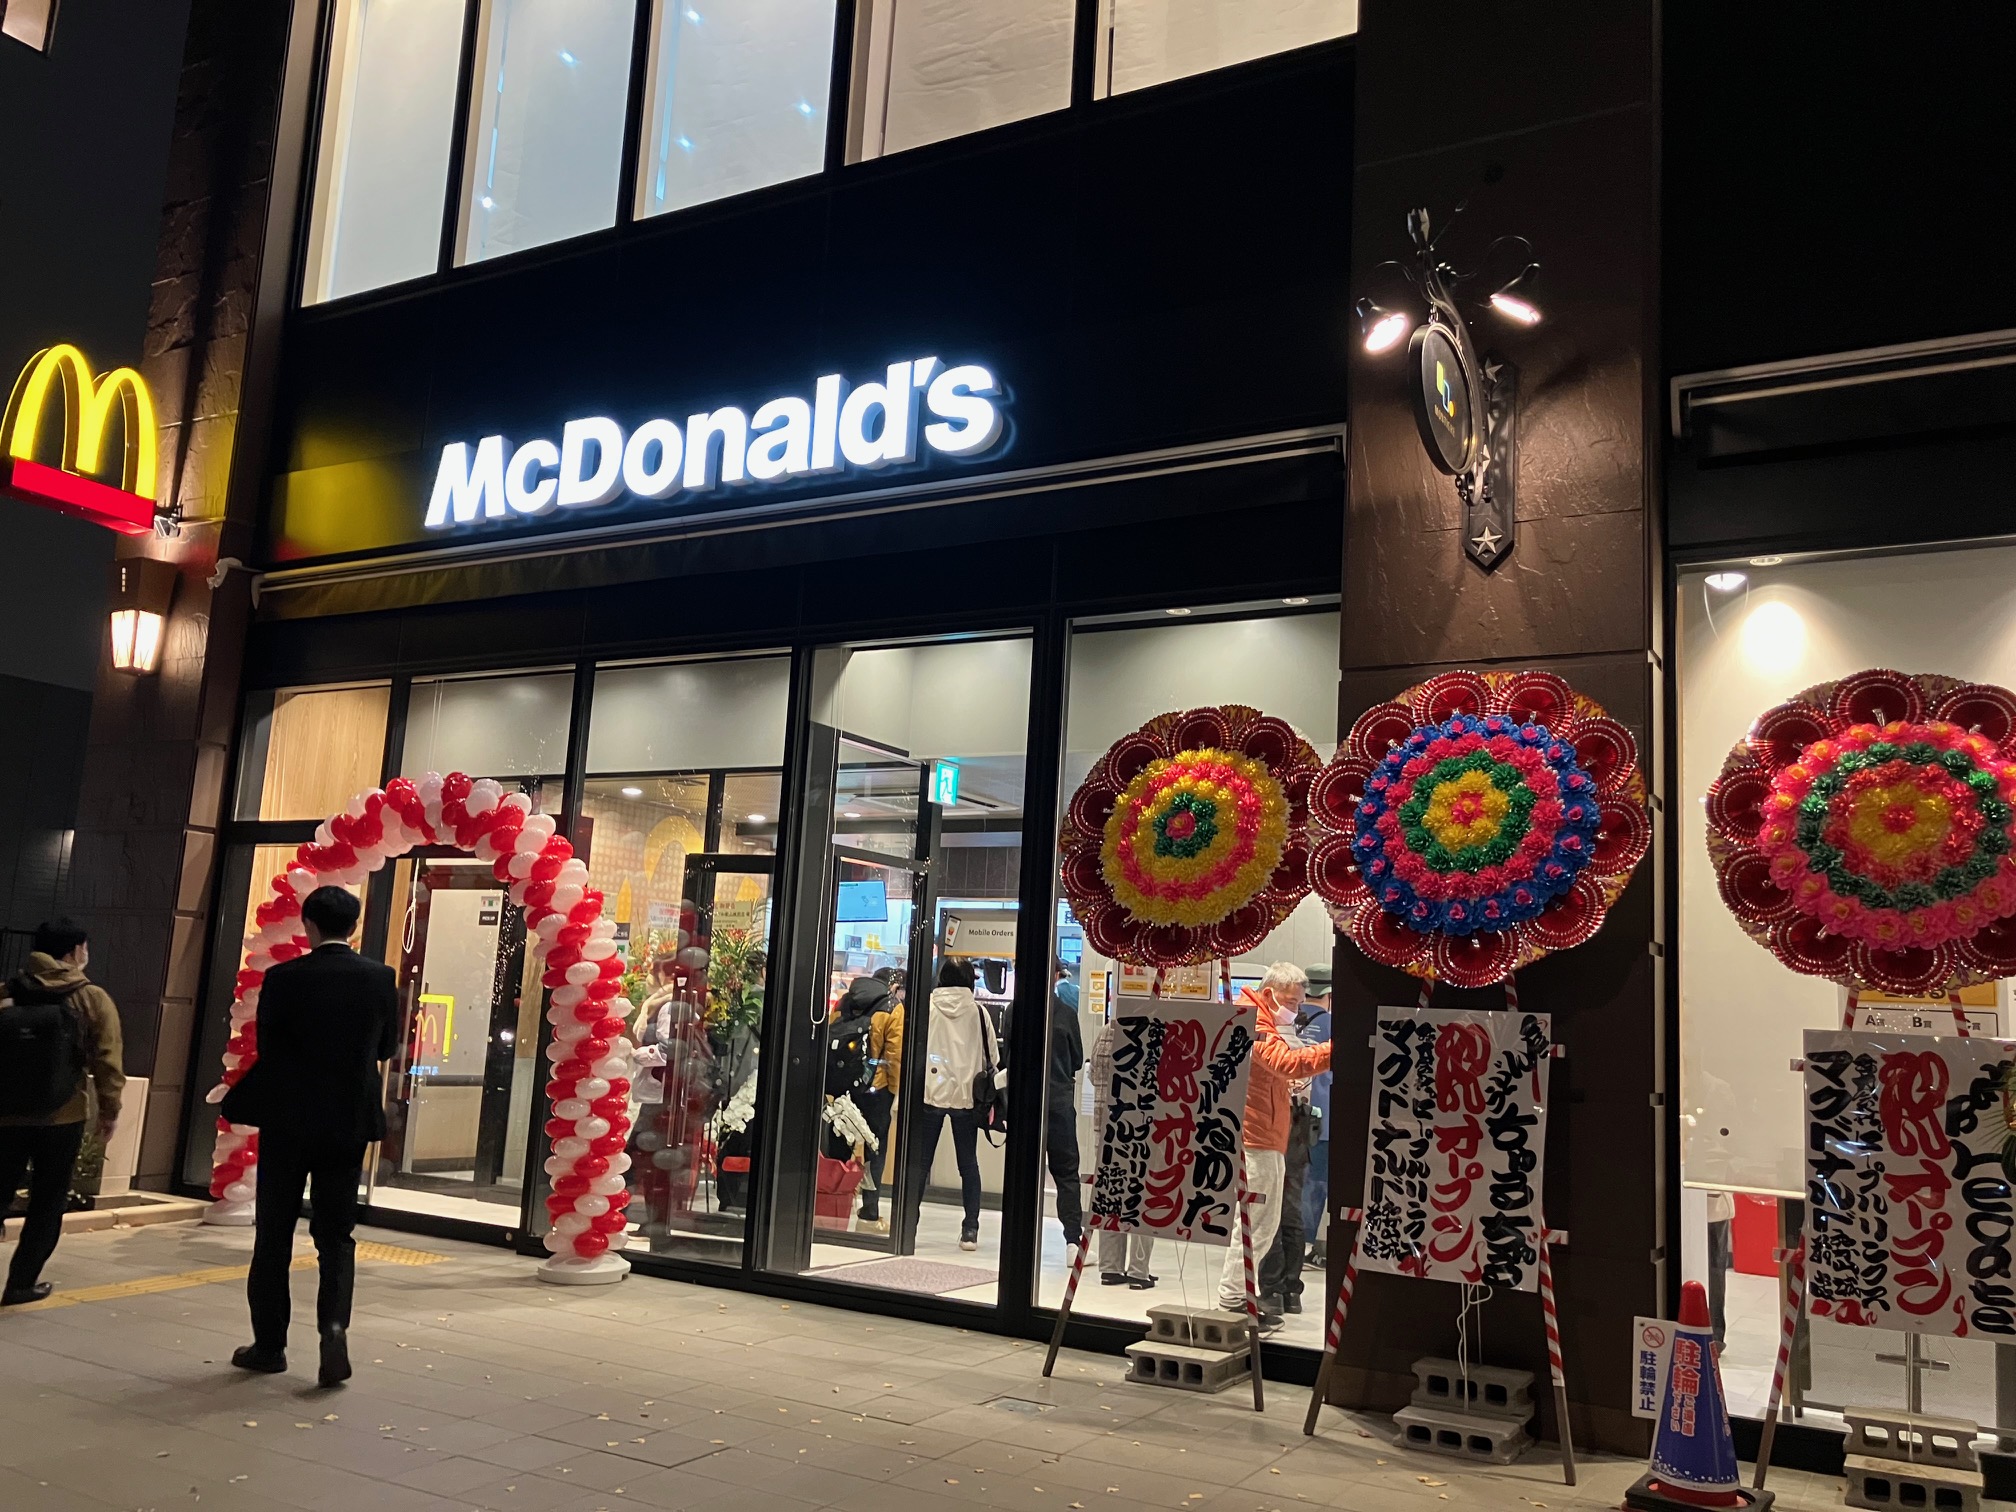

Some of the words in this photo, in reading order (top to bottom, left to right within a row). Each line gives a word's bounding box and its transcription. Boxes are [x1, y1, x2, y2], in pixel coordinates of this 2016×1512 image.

[425, 356, 1003, 529] McDonald's
[1102, 1016, 1150, 1166] マクドナルド
[1371, 1018, 1416, 1201] マクドナルド
[1807, 1050, 1856, 1232] マクドナルド
[1639, 1350, 1657, 1412] 駐輪禁止
